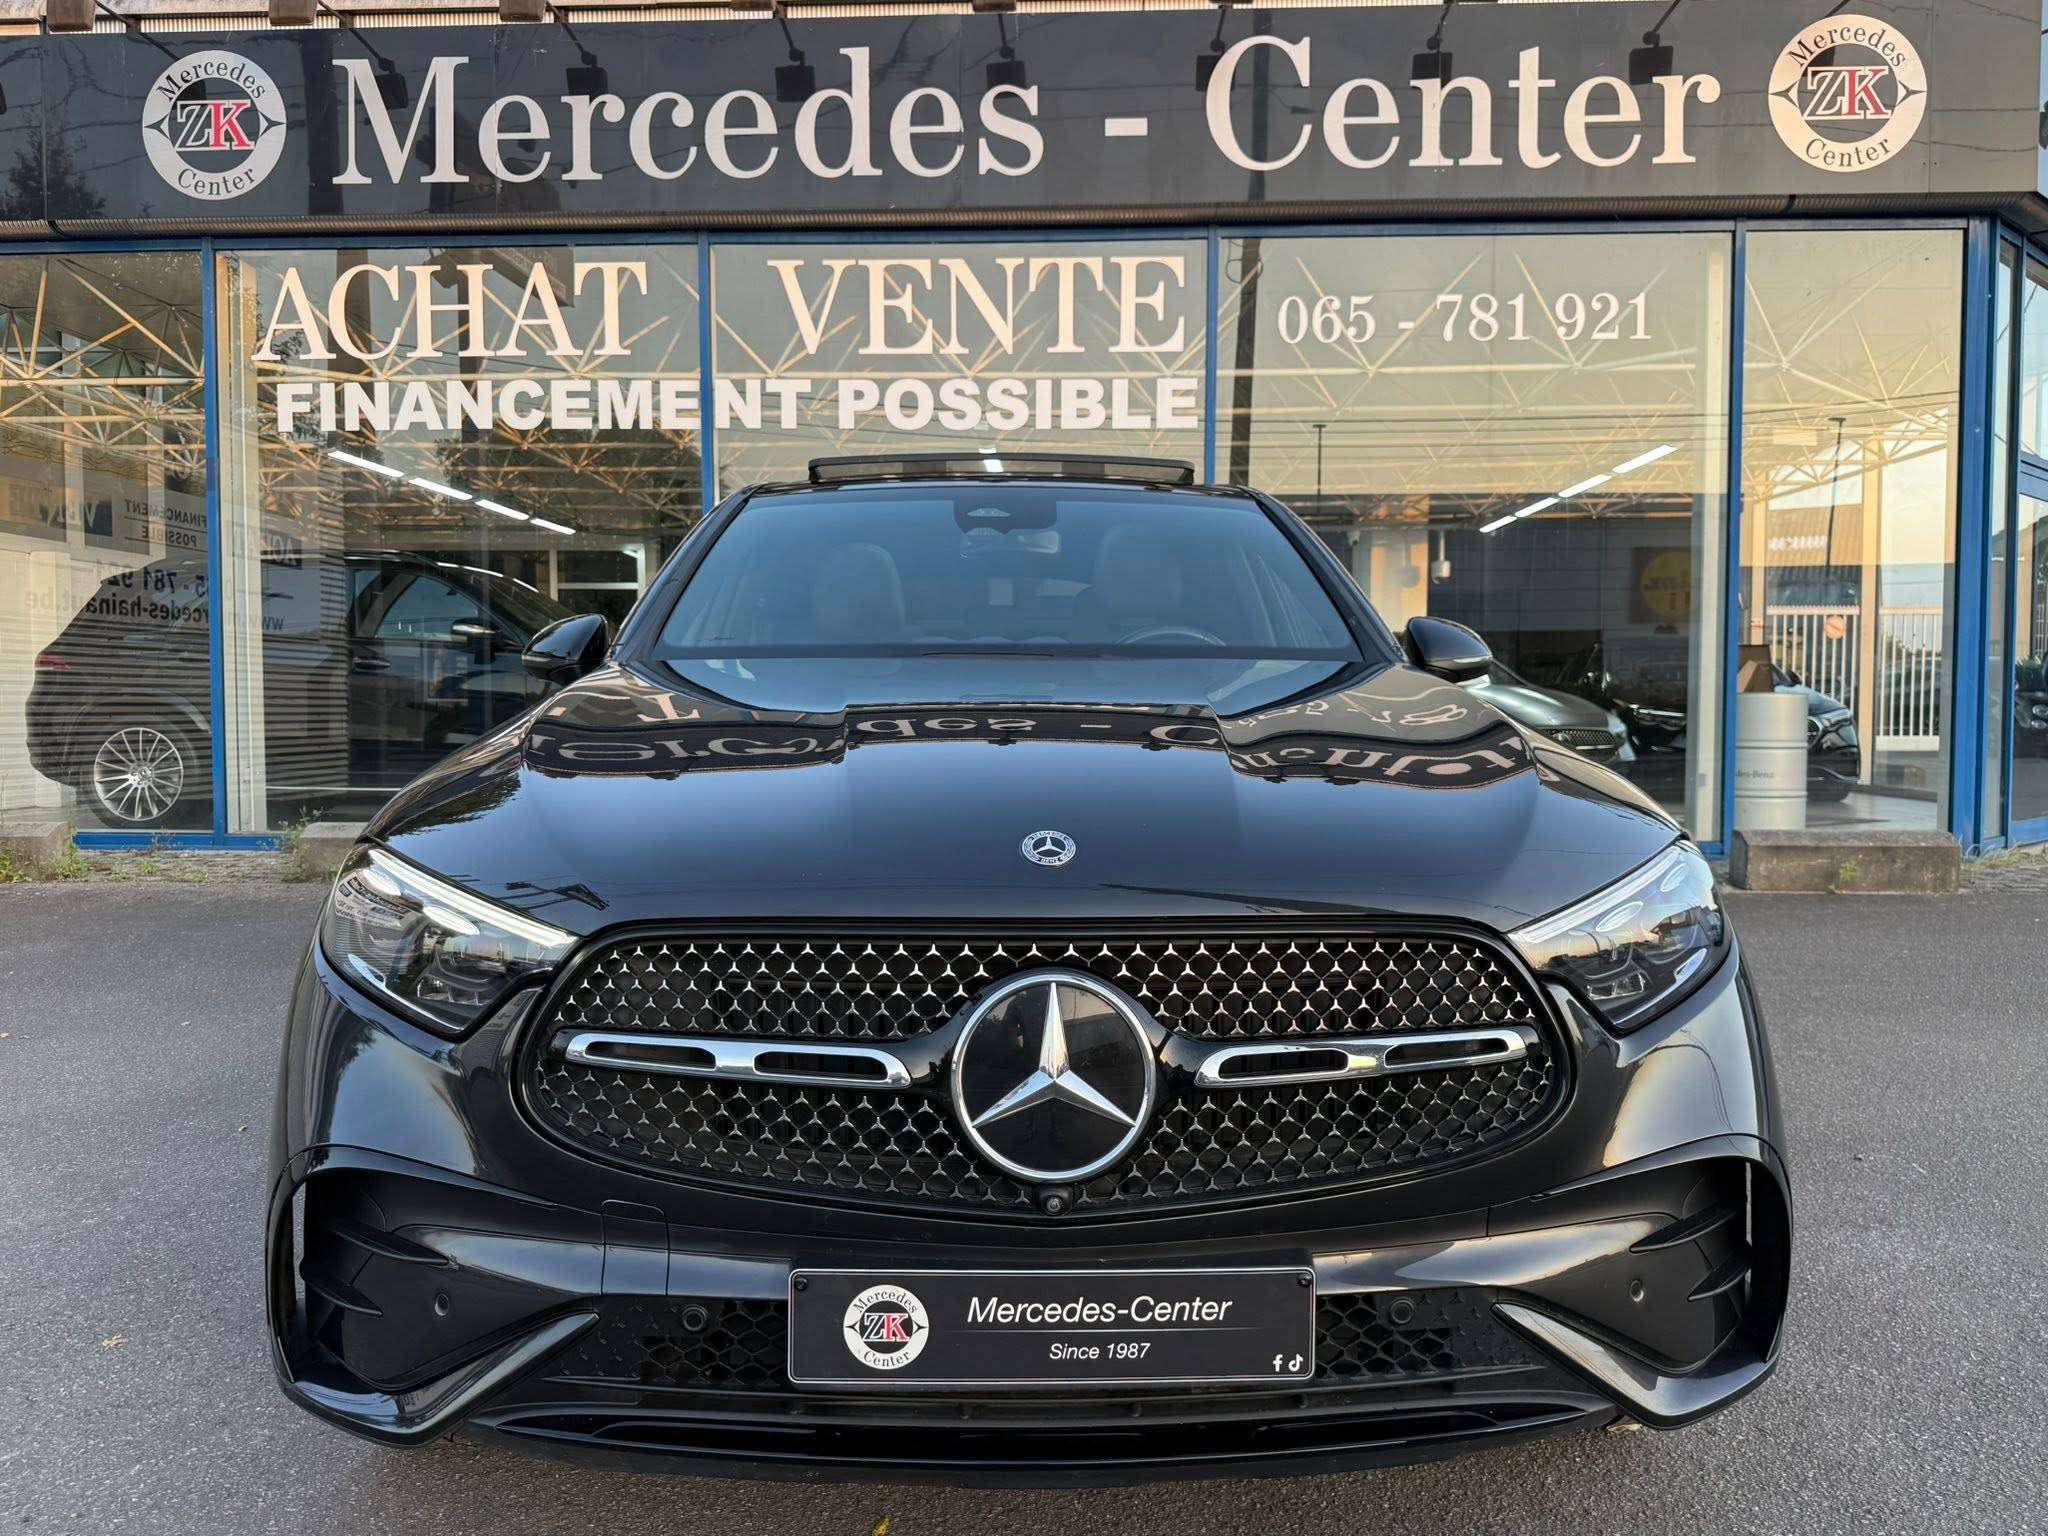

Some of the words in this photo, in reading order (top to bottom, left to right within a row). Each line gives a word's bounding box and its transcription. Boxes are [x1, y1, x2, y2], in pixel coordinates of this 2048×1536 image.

[1787, 26, 1907, 67] Mercedes
[156, 61, 266, 102] Mercedes
[1803, 66, 1893, 120] ZK
[174, 99, 256, 151] ZK
[332, 47, 1044, 185] Mercedes
[1104, 117, 1148, 136] -
[1206, 35, 1721, 171] Center
[1806, 138, 1890, 168] Center
[178, 168, 256, 196] Center
[251, 262, 647, 362] ACHAT
[767, 256, 1185, 355] VENTE
[1278, 295, 1375, 345] 065
[1435, 292, 1531, 342] 781
[1554, 291, 1652, 341] 921
[276, 378, 814, 433] FINANCEMENT
[837, 376, 1199, 431] POSSIBLE
[853, 1291, 917, 1314] Mercedes
[967, 1295, 1233, 1323] Mercedes-Center
[862, 1312, 910, 1342] ZK
[863, 1351, 909, 1367] Center
[1049, 1343, 1100, 1360] Since
[1107, 1342, 1151, 1359] 1987
